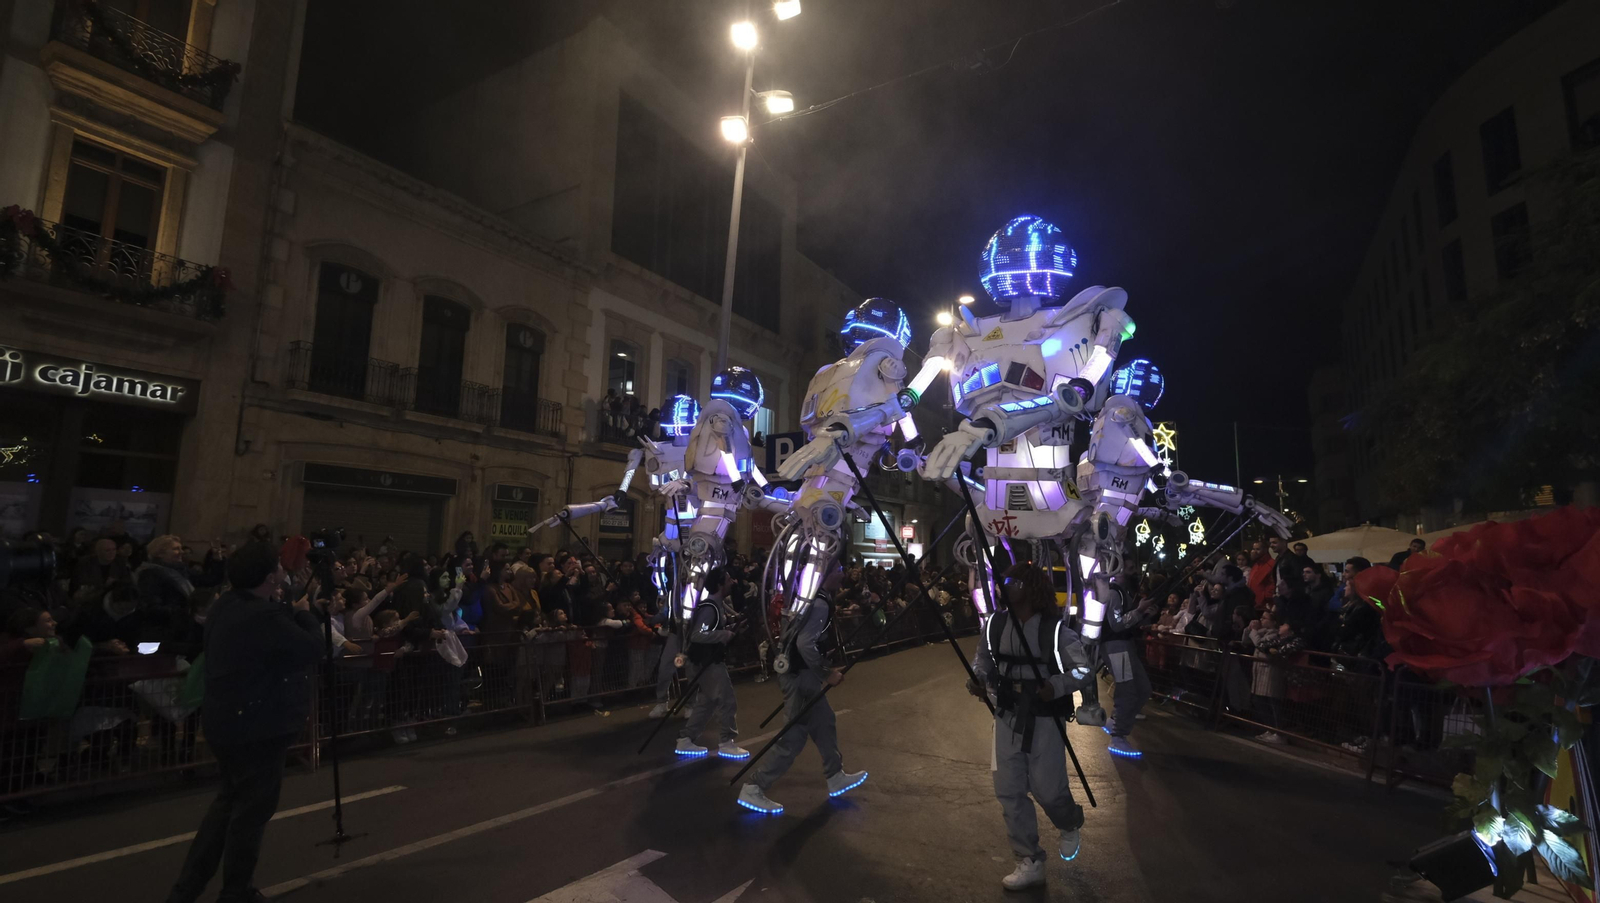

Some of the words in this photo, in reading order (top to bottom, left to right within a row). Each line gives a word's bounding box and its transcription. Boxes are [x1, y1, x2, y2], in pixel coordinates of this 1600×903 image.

[37, 363, 186, 403] cajamar
[775, 437, 795, 472] P
[1111, 477, 1129, 490] RM
[712, 487, 729, 501] RM
[493, 509, 502, 519] SE
[505, 509, 529, 520] VENDE
[492, 524, 497, 534] O
[498, 524, 528, 536] ALQUILA
